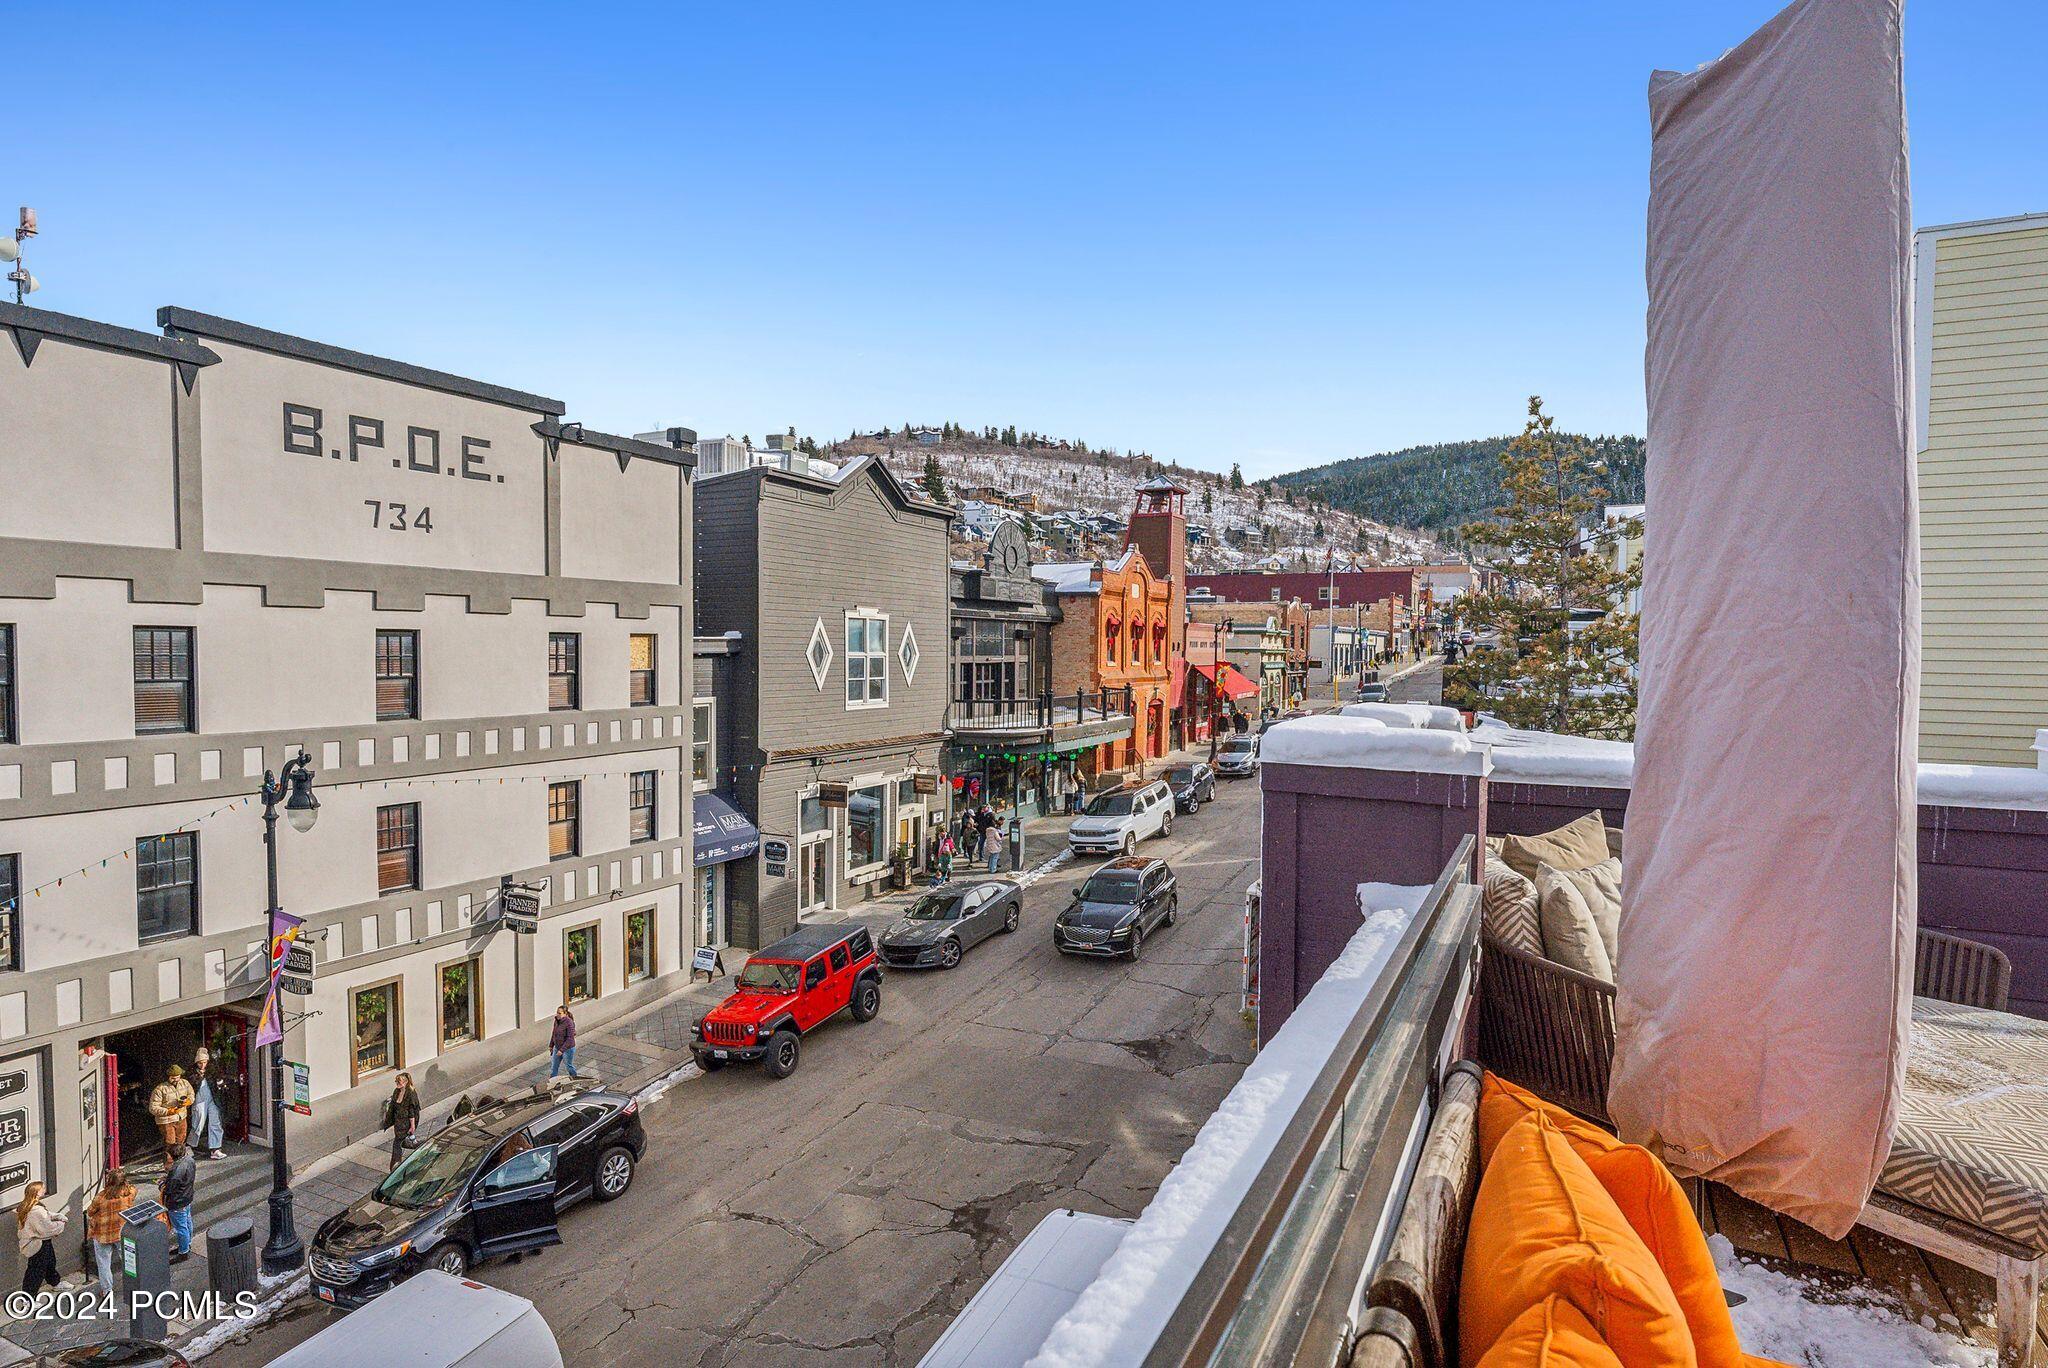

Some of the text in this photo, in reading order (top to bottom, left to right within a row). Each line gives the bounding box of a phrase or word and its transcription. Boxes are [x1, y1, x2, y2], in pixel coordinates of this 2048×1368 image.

[283, 402, 505, 484] B.P.O.E.
[364, 500, 434, 534] 734
[509, 897, 538, 909] TANNER
[509, 904, 538, 914] TRADING
[0, 1118, 21, 1135] R
